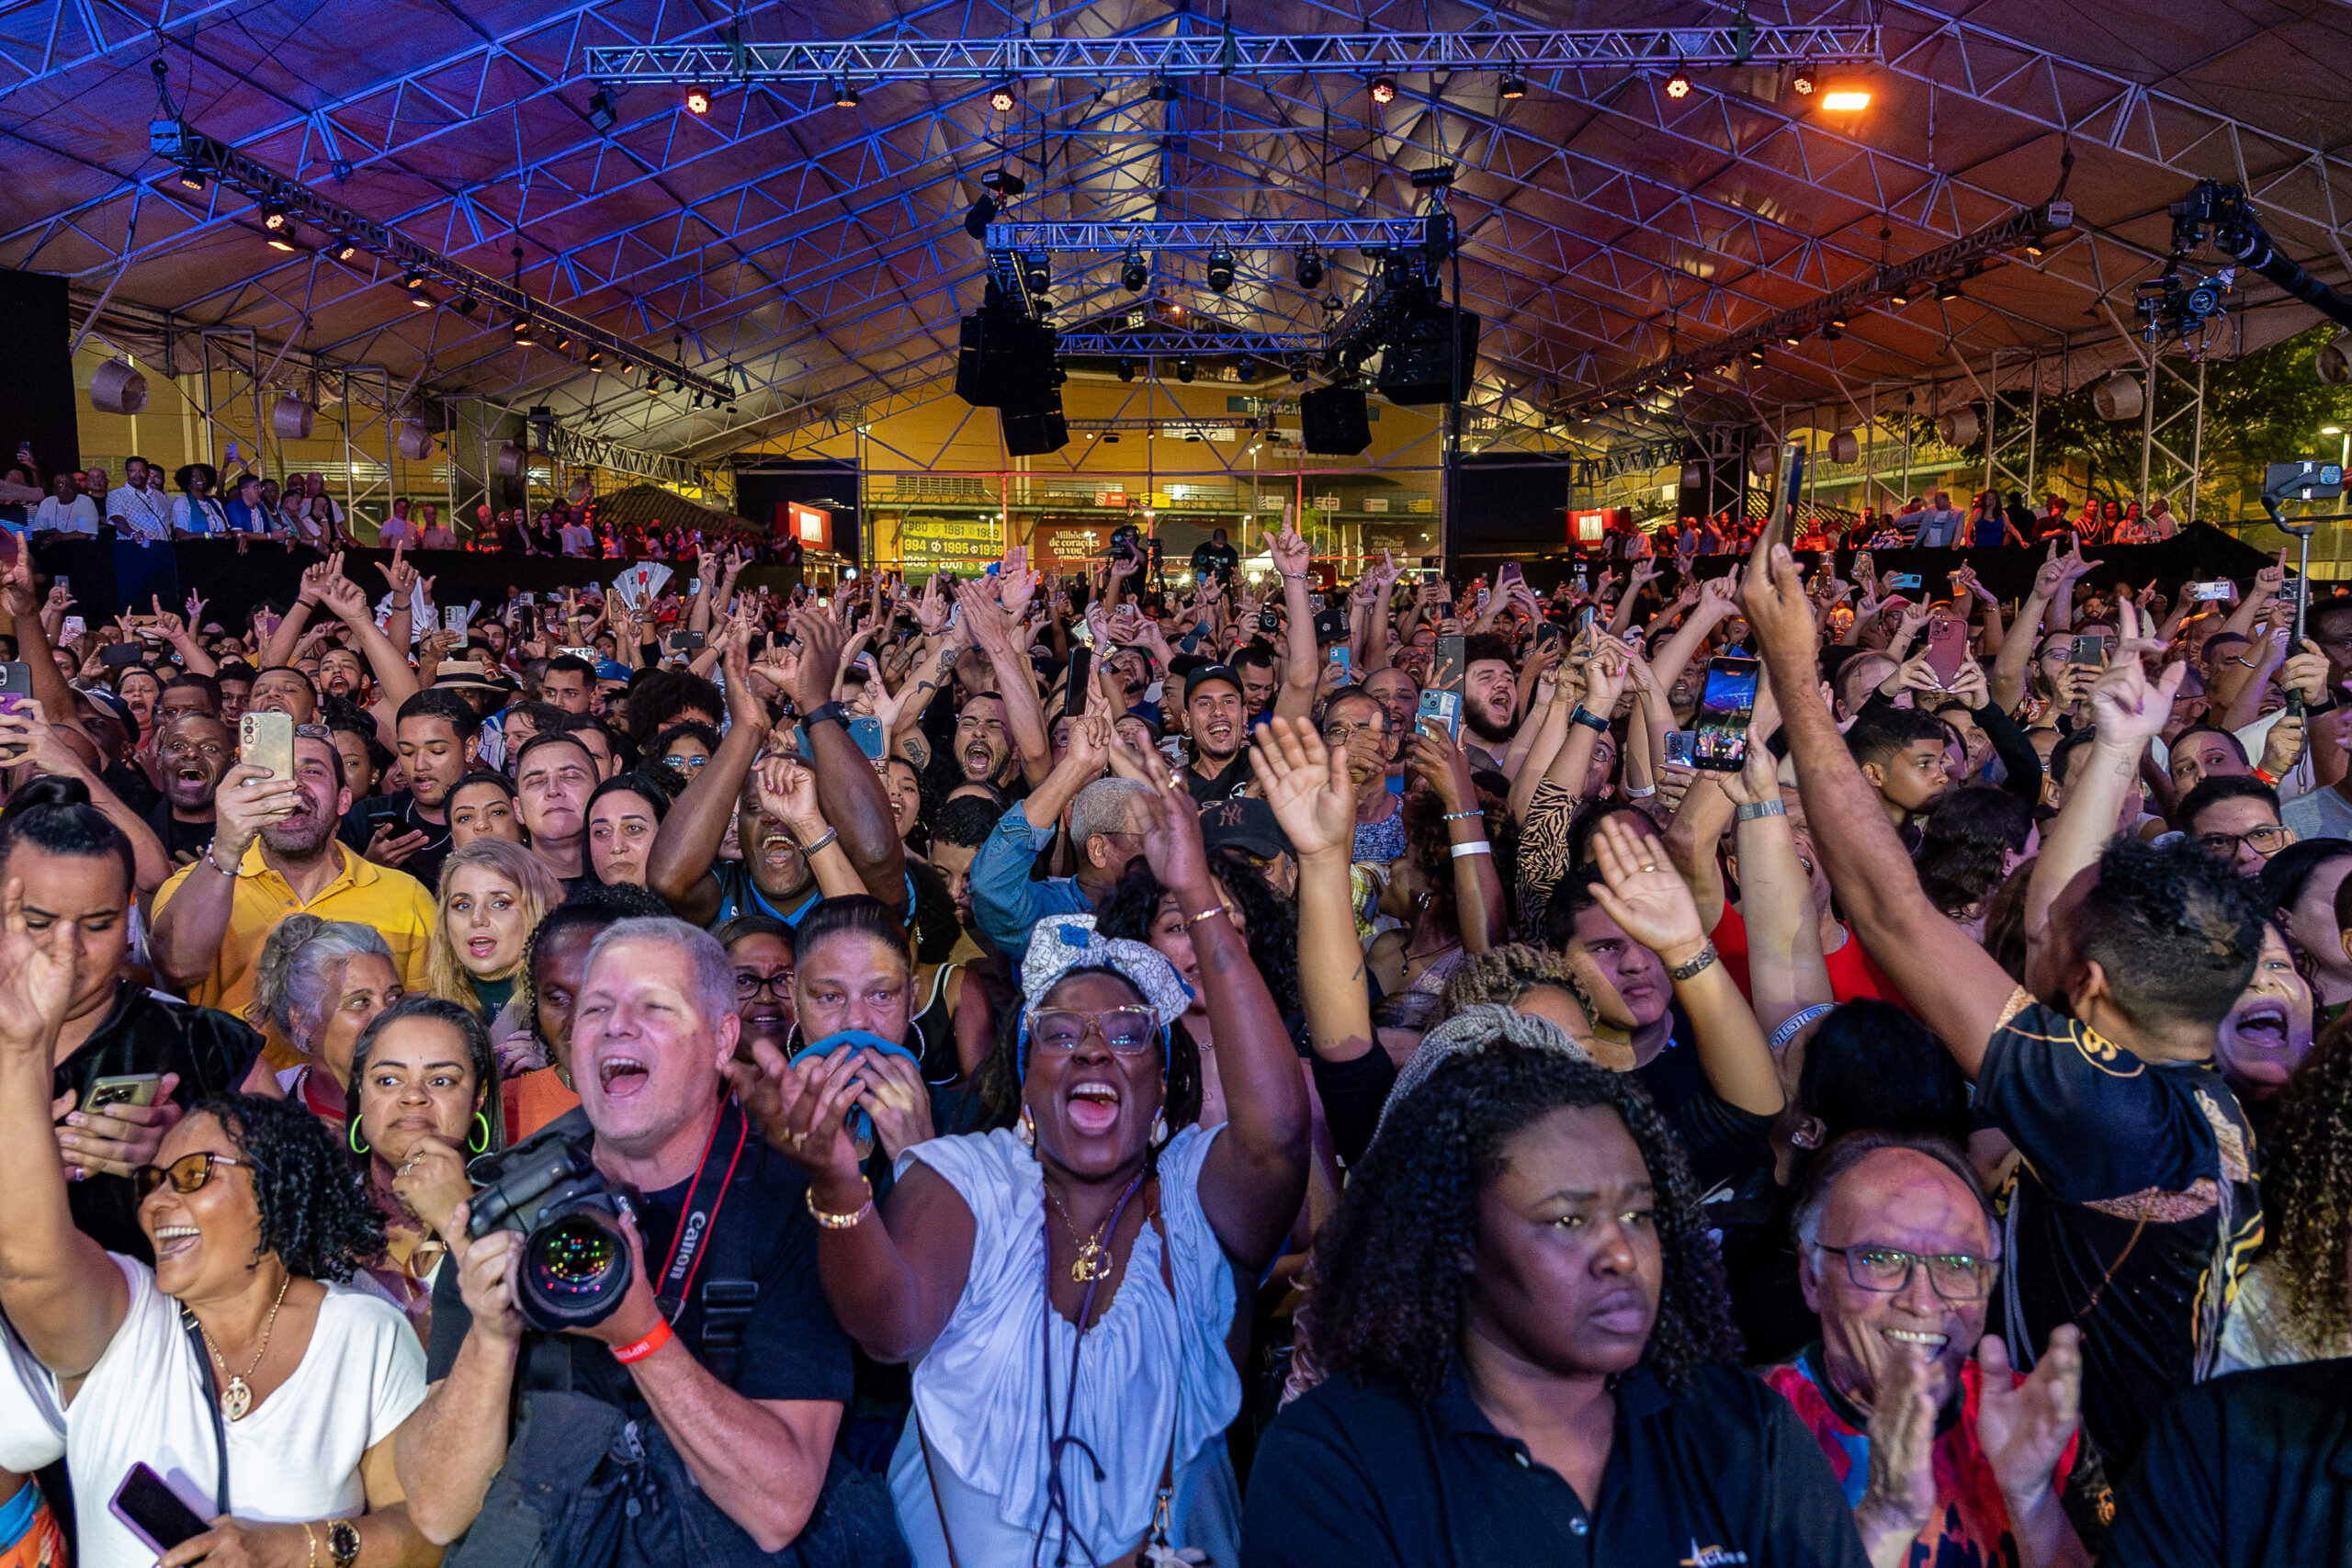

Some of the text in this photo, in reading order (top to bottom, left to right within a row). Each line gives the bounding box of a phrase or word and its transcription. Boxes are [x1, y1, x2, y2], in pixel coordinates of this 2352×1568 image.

[904, 521, 1000, 538] 1980 1981 1989
[904, 538, 1003, 557] 994 1995 1999
[1048, 537, 1100, 549] de corações
[939, 558, 963, 570] 2001
[669, 1210, 707, 1280] Canon
